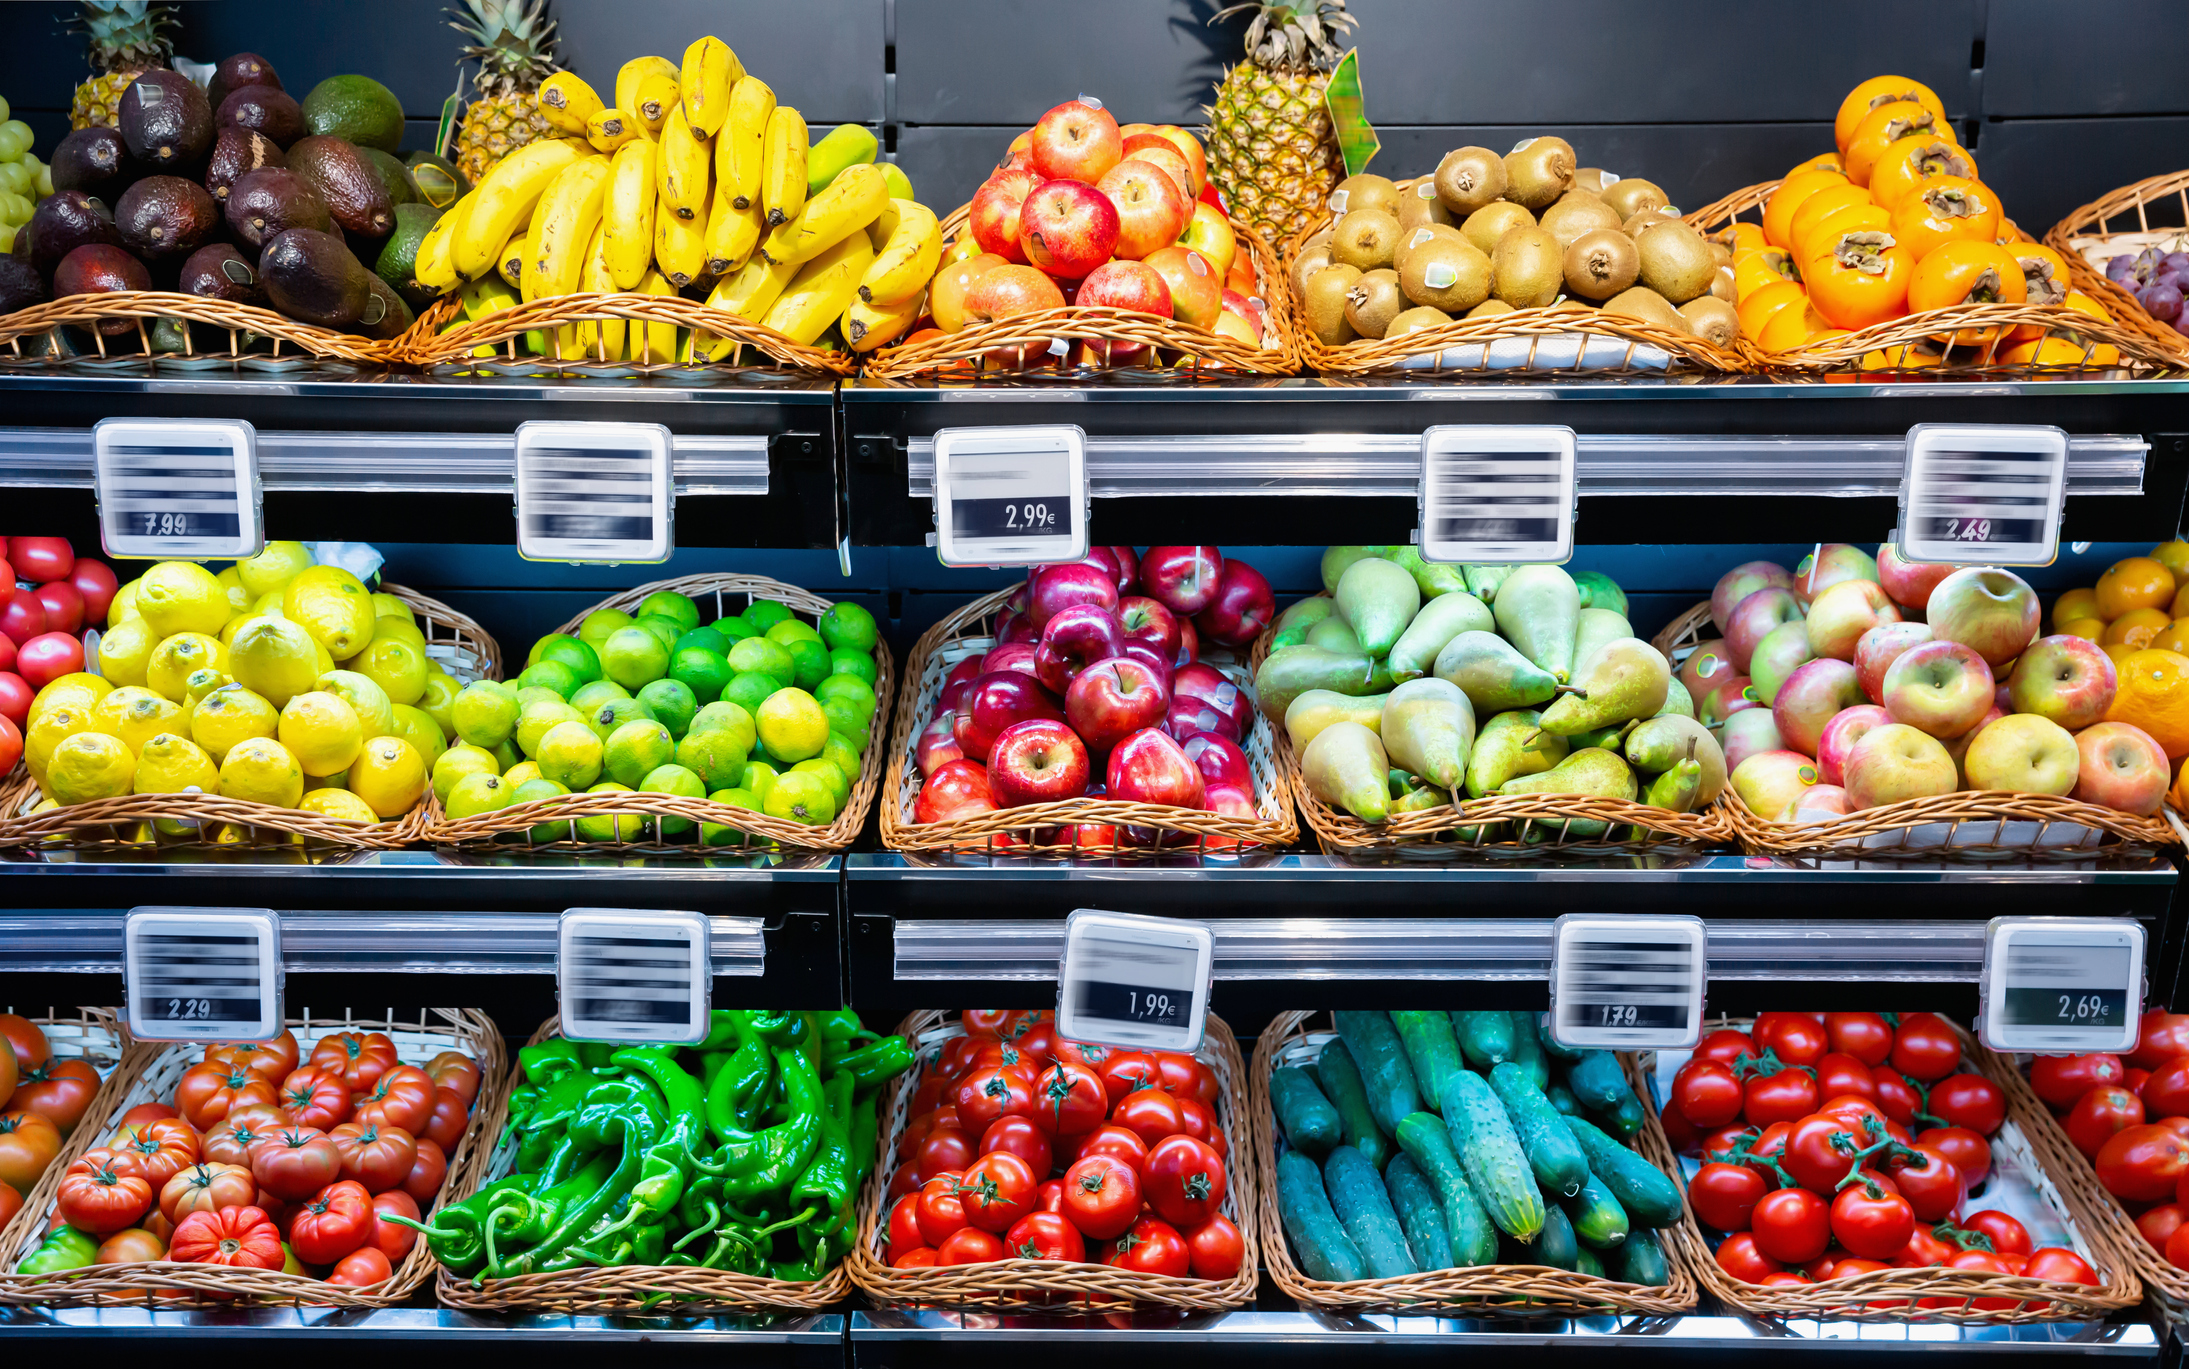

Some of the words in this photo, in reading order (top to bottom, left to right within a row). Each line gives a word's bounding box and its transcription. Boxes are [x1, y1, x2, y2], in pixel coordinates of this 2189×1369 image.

[144, 513, 187, 535] 7,99
[1005, 504, 1055, 532] 2,99€
[1943, 518, 1991, 541] 2,49
[167, 998, 211, 1020] 2,29
[1130, 991, 1176, 1020] 1,99€
[1601, 1005, 1637, 1026] 1,79
[2058, 994, 2109, 1022] 2,69€
